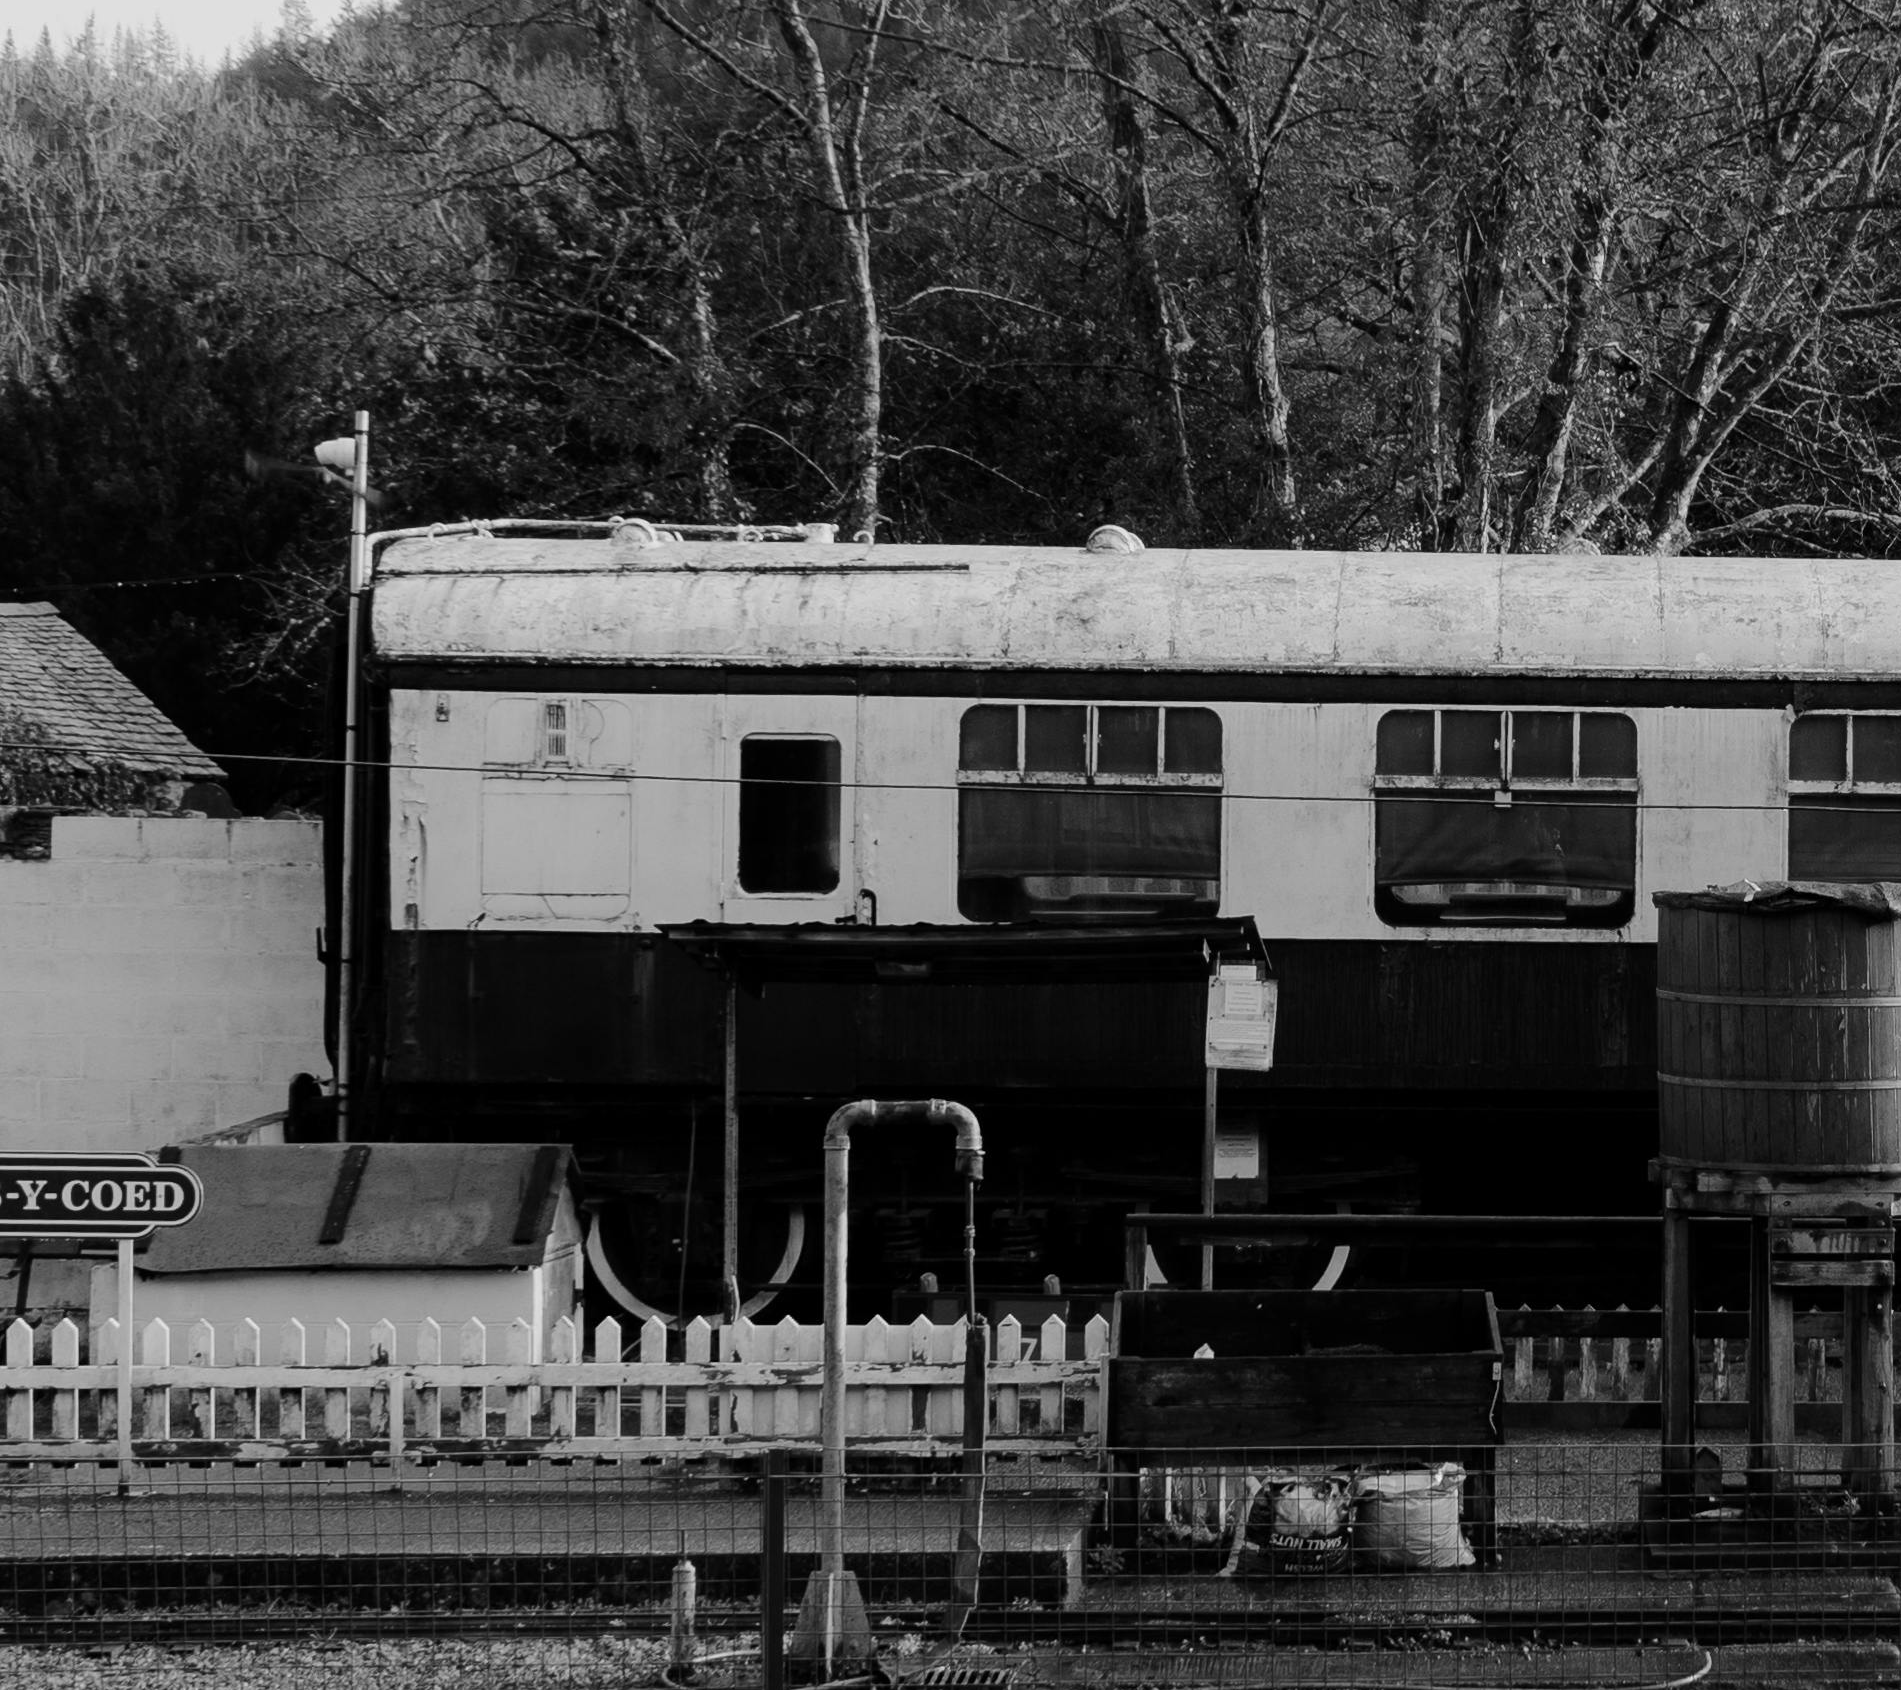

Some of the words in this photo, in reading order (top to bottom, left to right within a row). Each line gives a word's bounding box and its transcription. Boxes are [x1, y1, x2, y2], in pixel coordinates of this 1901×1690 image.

[0, 1179, 185, 1212] -Y-COED
[1269, 1533, 1305, 1551] NUTS
[1305, 1536, 1344, 1551] SMALL
[1284, 1563, 1325, 1574] WELSH
